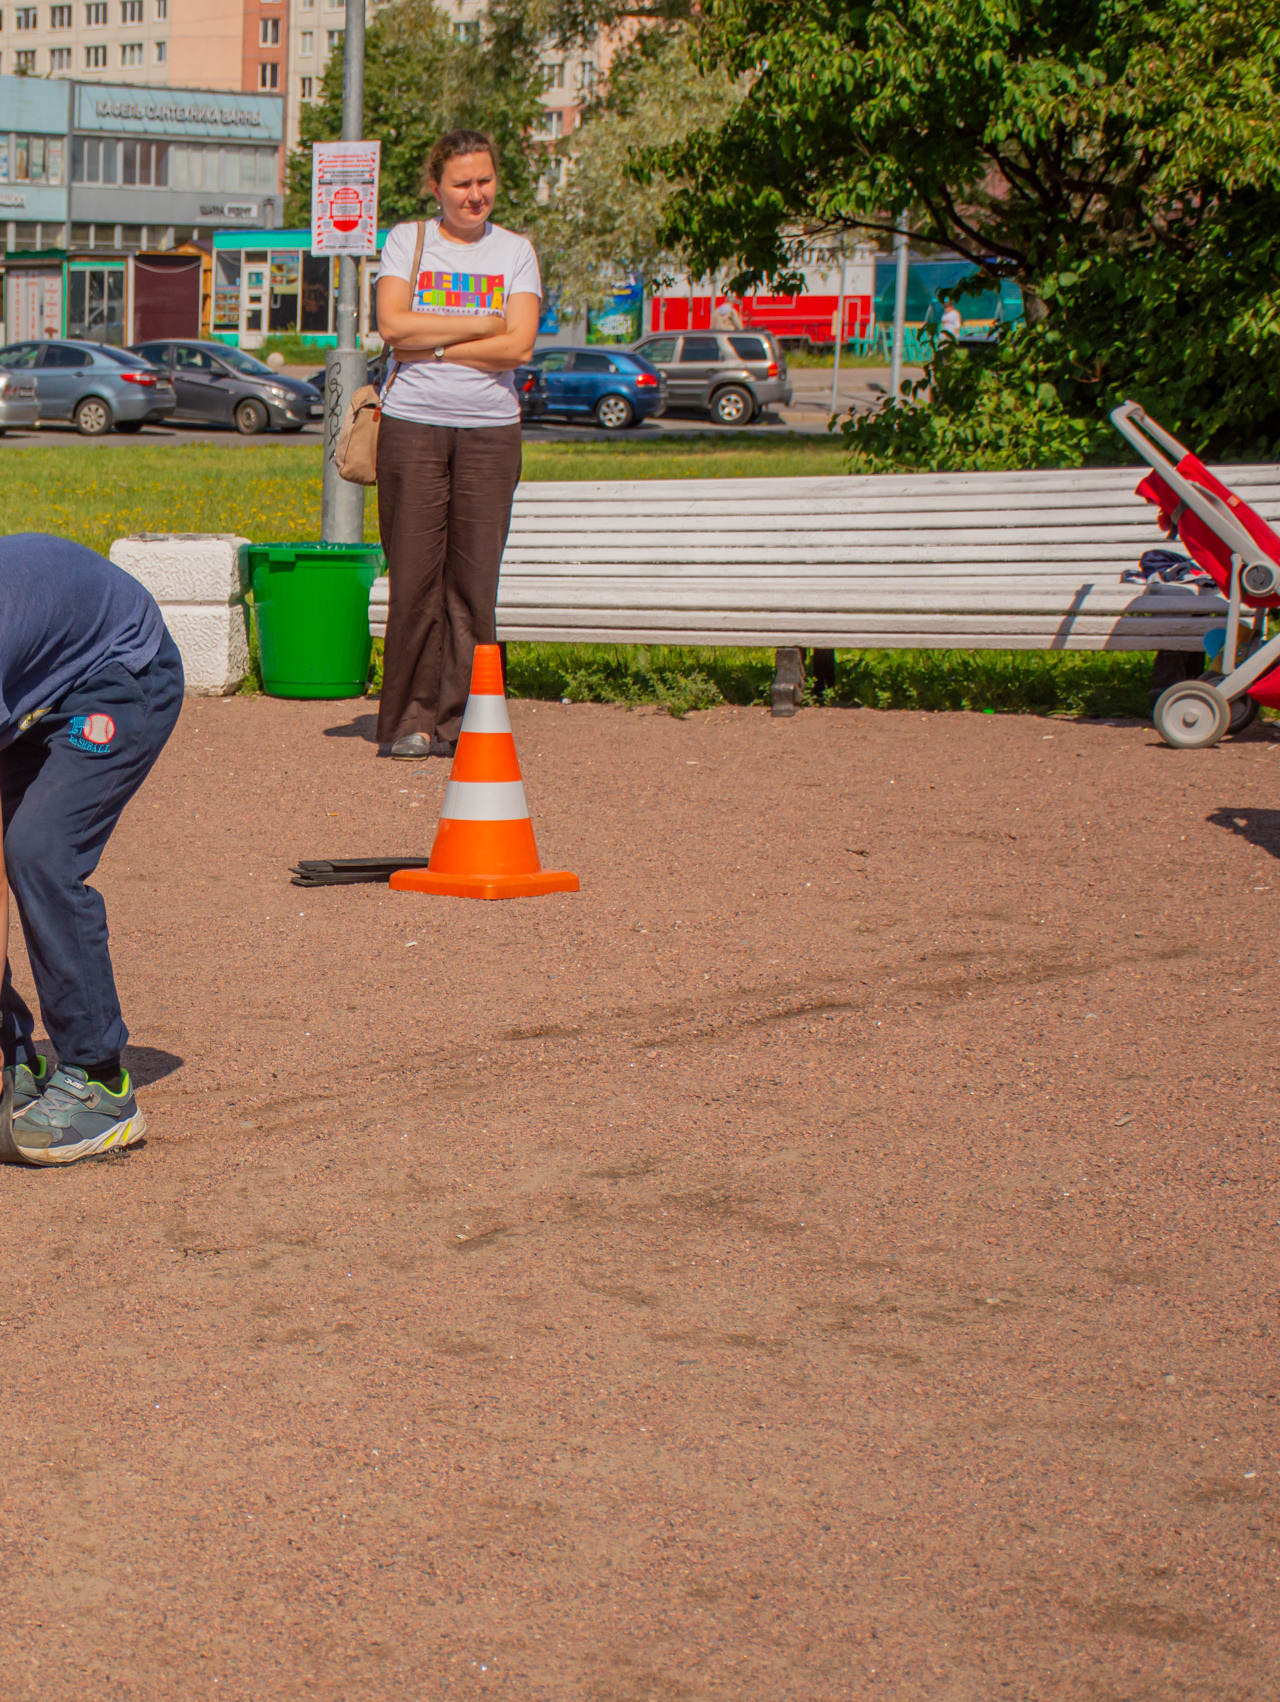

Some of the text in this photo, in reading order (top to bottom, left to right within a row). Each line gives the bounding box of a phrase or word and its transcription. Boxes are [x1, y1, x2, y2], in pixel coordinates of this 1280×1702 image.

[96, 100, 263, 127] КАФЕЛЬ САНТЕХНИКА ВАННЫ
[417, 271, 504, 293] ЦЕНТР
[417, 289, 504, 310] СПОРТА
